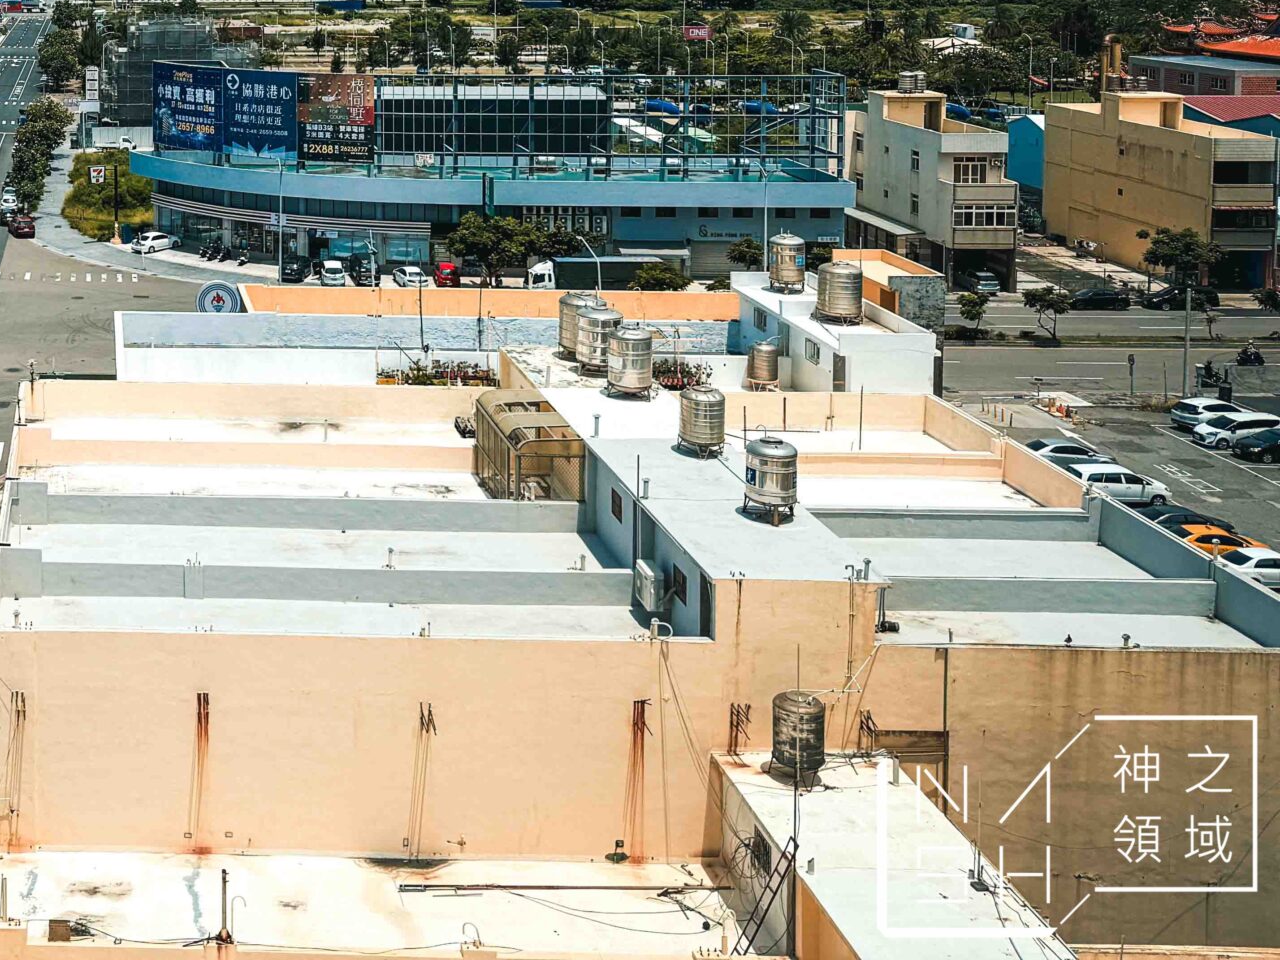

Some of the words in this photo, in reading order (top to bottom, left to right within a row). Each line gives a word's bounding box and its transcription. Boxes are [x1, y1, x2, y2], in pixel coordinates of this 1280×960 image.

[242, 83, 292, 100] 協勝港心
[309, 144, 334, 154] 2X88
